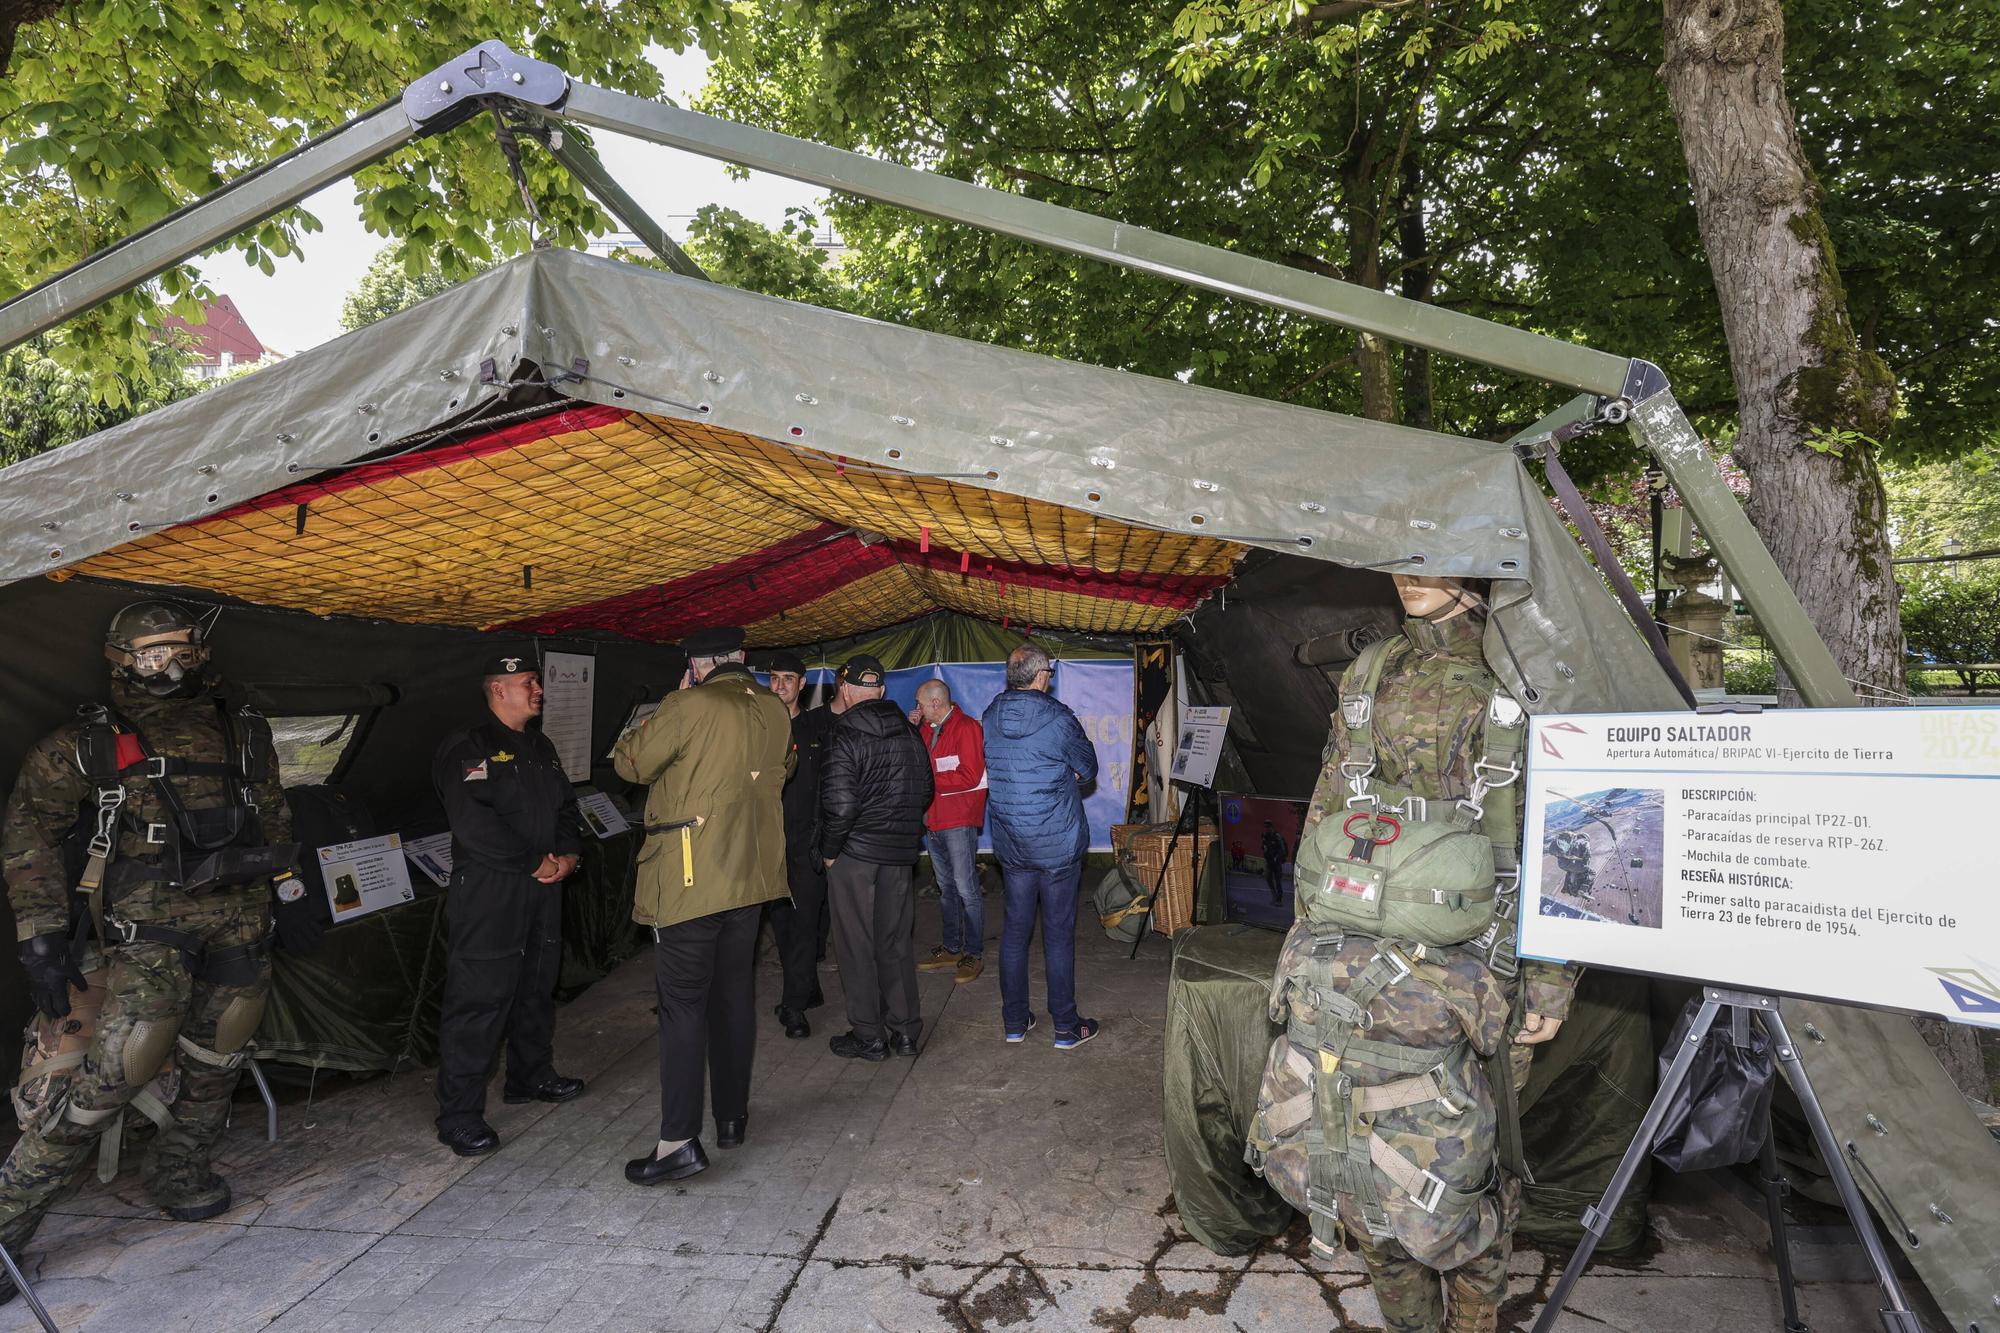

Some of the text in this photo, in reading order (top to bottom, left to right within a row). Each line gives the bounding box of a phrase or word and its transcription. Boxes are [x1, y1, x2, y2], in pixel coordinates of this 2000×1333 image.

[1607, 726, 1751, 742] EQUIPO SALTADOR
[1920, 713, 1998, 735] DIFAS
[1606, 746, 1893, 761] Apertura Automática/ BRIPAC VI-Ejercito de Tierra
[1921, 736, 2000, 759] 2024
[1682, 788, 1757, 802] DESCRIPCIÓN:
[1682, 808, 1872, 828] -Paracaídas principal TP2Z-01.
[1682, 828, 1888, 852] -Paracaídas de reserva RTP-26Z.
[1682, 849, 1810, 868] -Mochila de combate.
[1681, 868, 1793, 890] RESEÑA HISTÓRICA:
[1681, 890, 1956, 928] -Primer salto paracaidista del Ejercito de
[1680, 906, 1861, 937] Tierra 23 de febrero de 1954.
